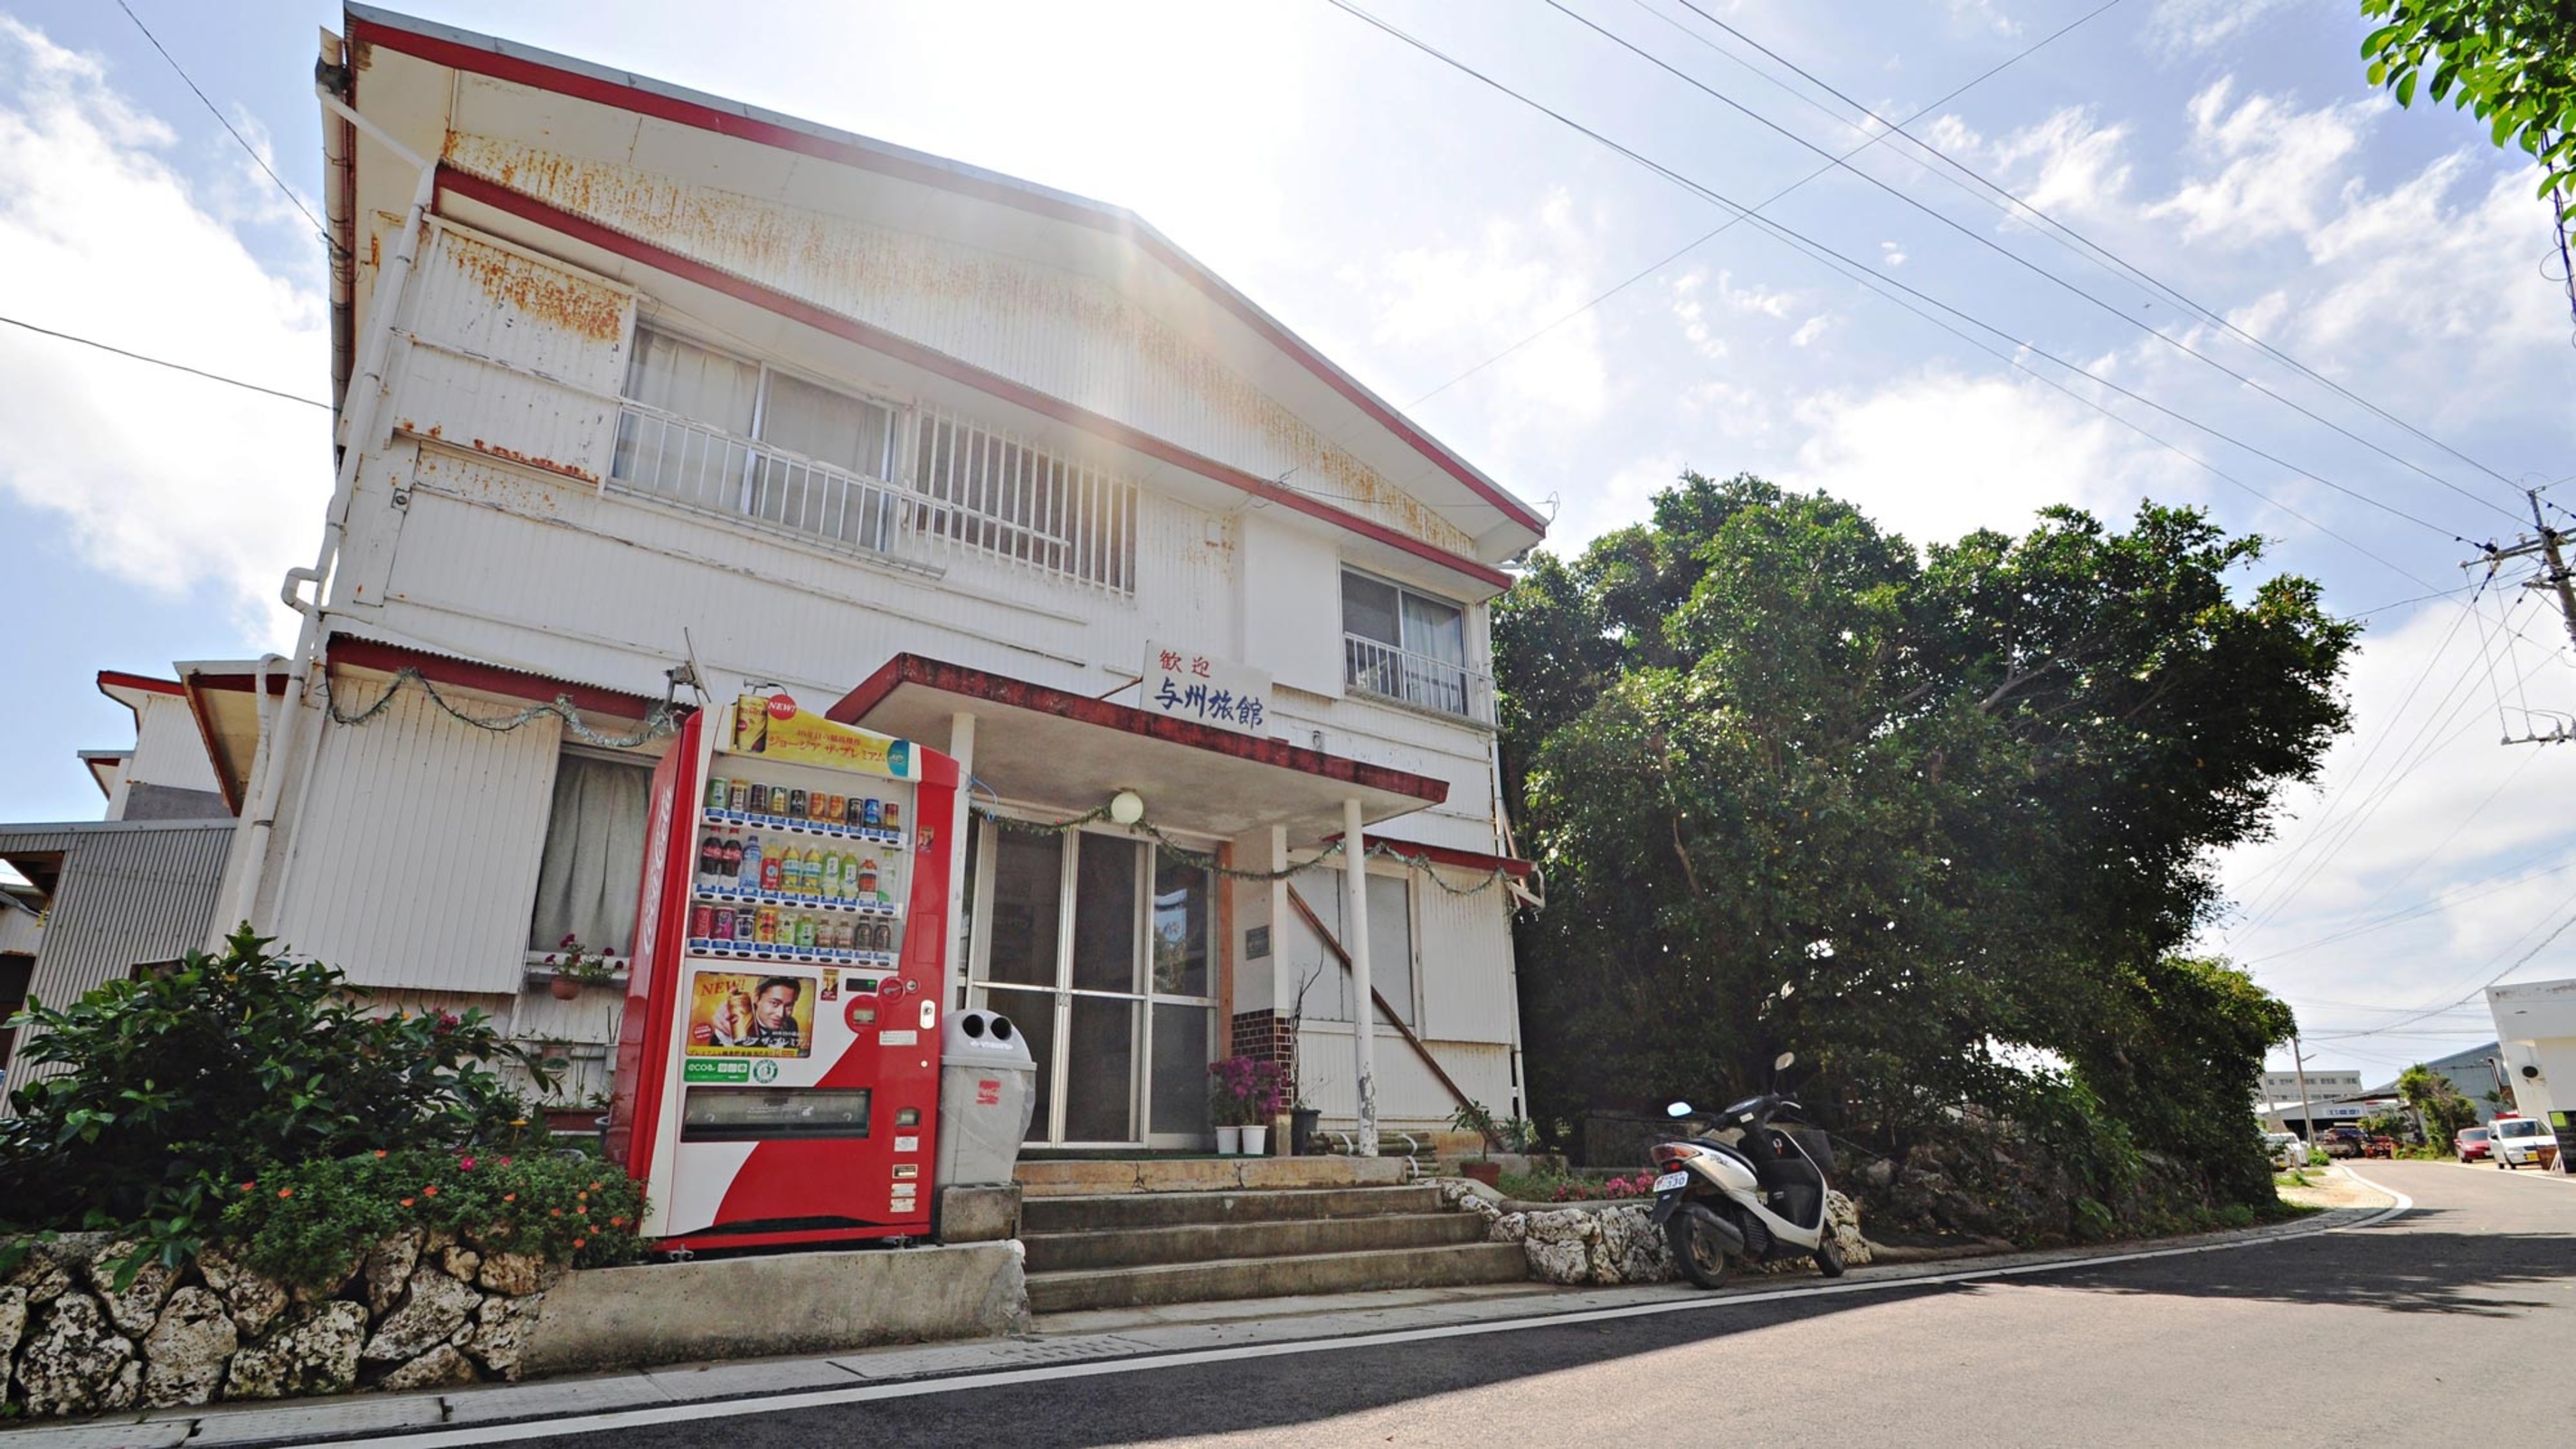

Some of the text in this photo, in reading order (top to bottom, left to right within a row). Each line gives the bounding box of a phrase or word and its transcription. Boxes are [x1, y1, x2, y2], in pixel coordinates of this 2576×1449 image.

[1160, 649, 1211, 678] 歓迎
[768, 702, 796, 714] NEW!
[1154, 677, 1264, 730] 与州旅館
